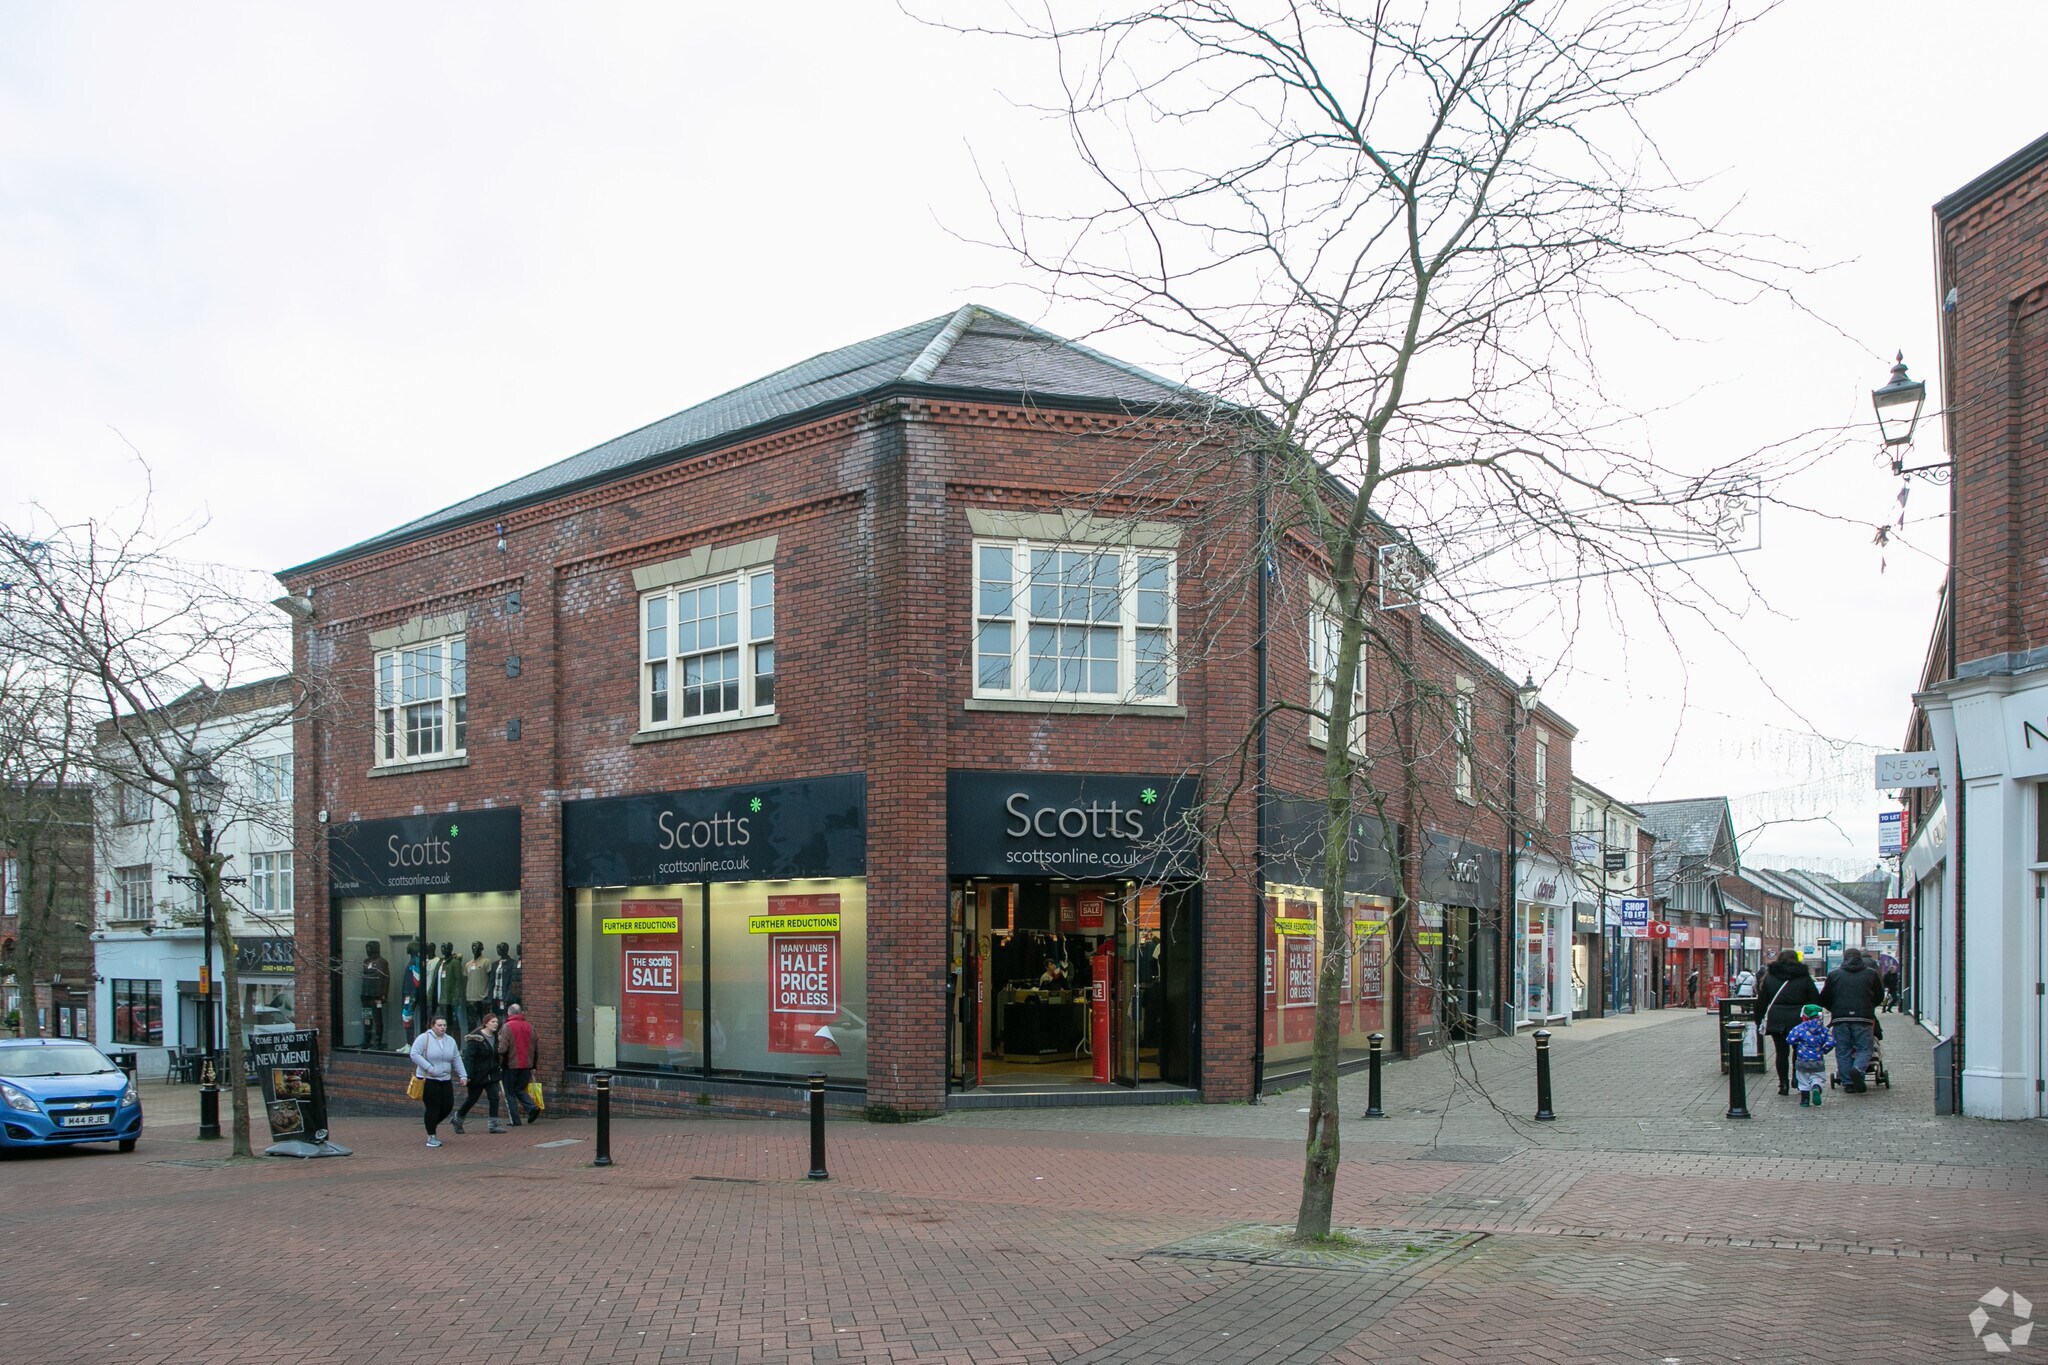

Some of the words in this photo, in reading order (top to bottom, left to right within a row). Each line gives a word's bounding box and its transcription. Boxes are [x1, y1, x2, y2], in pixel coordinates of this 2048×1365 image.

[1885, 759, 1927, 770] NEW
[1881, 771, 1931, 782] LOOK
[1006, 792, 1144, 839] Scotts
[658, 810, 751, 850] Scotts
[388, 834, 451, 867] Scotts
[1006, 848, 1142, 865] scottsonline.co.uk
[658, 855, 750, 874] scottsonline.co.uk
[388, 872, 451, 887] scottsonline.co.uk
[1624, 902, 1645, 911] SHOP
[1623, 911, 1633, 919] TO
[604, 922, 633, 930] FURTHER
[634, 920, 677, 930] REDUCTIONS
[751, 919, 785, 929] FURTHER
[787, 917, 838, 928] REDUCTIONS
[780, 944, 804, 953] MANY
[805, 943, 828, 953] LINES
[632, 957, 647, 967] THE
[648, 955, 673, 967] scotts
[780, 954, 828, 972] HALF
[1289, 953, 1311, 969] HALF
[1363, 952, 1381, 967] HALF
[632, 967, 673, 987] SALE
[1289, 970, 1311, 986] PRICE
[1363, 967, 1381, 981] PRICE
[780, 973, 828, 991] PRICE
[1363, 983, 1370, 993] OR
[1370, 983, 1381, 993] LESS
[781, 992, 798, 1005] OR
[800, 992, 828, 1006] LESS
[1289, 988, 1298, 999] OR
[1298, 987, 1312, 999] LESS
[255, 1036, 272, 1045] COME
[273, 1035, 280, 1043] IN
[281, 1034, 295, 1043] AND
[295, 1033, 309, 1042] TRY
[274, 1044, 289, 1052] OUR
[256, 1053, 279, 1066] NEW
[281, 1051, 311, 1065] MENU
[68, 1116, 86, 1125] M44
[88, 1116, 105, 1124] RJE
